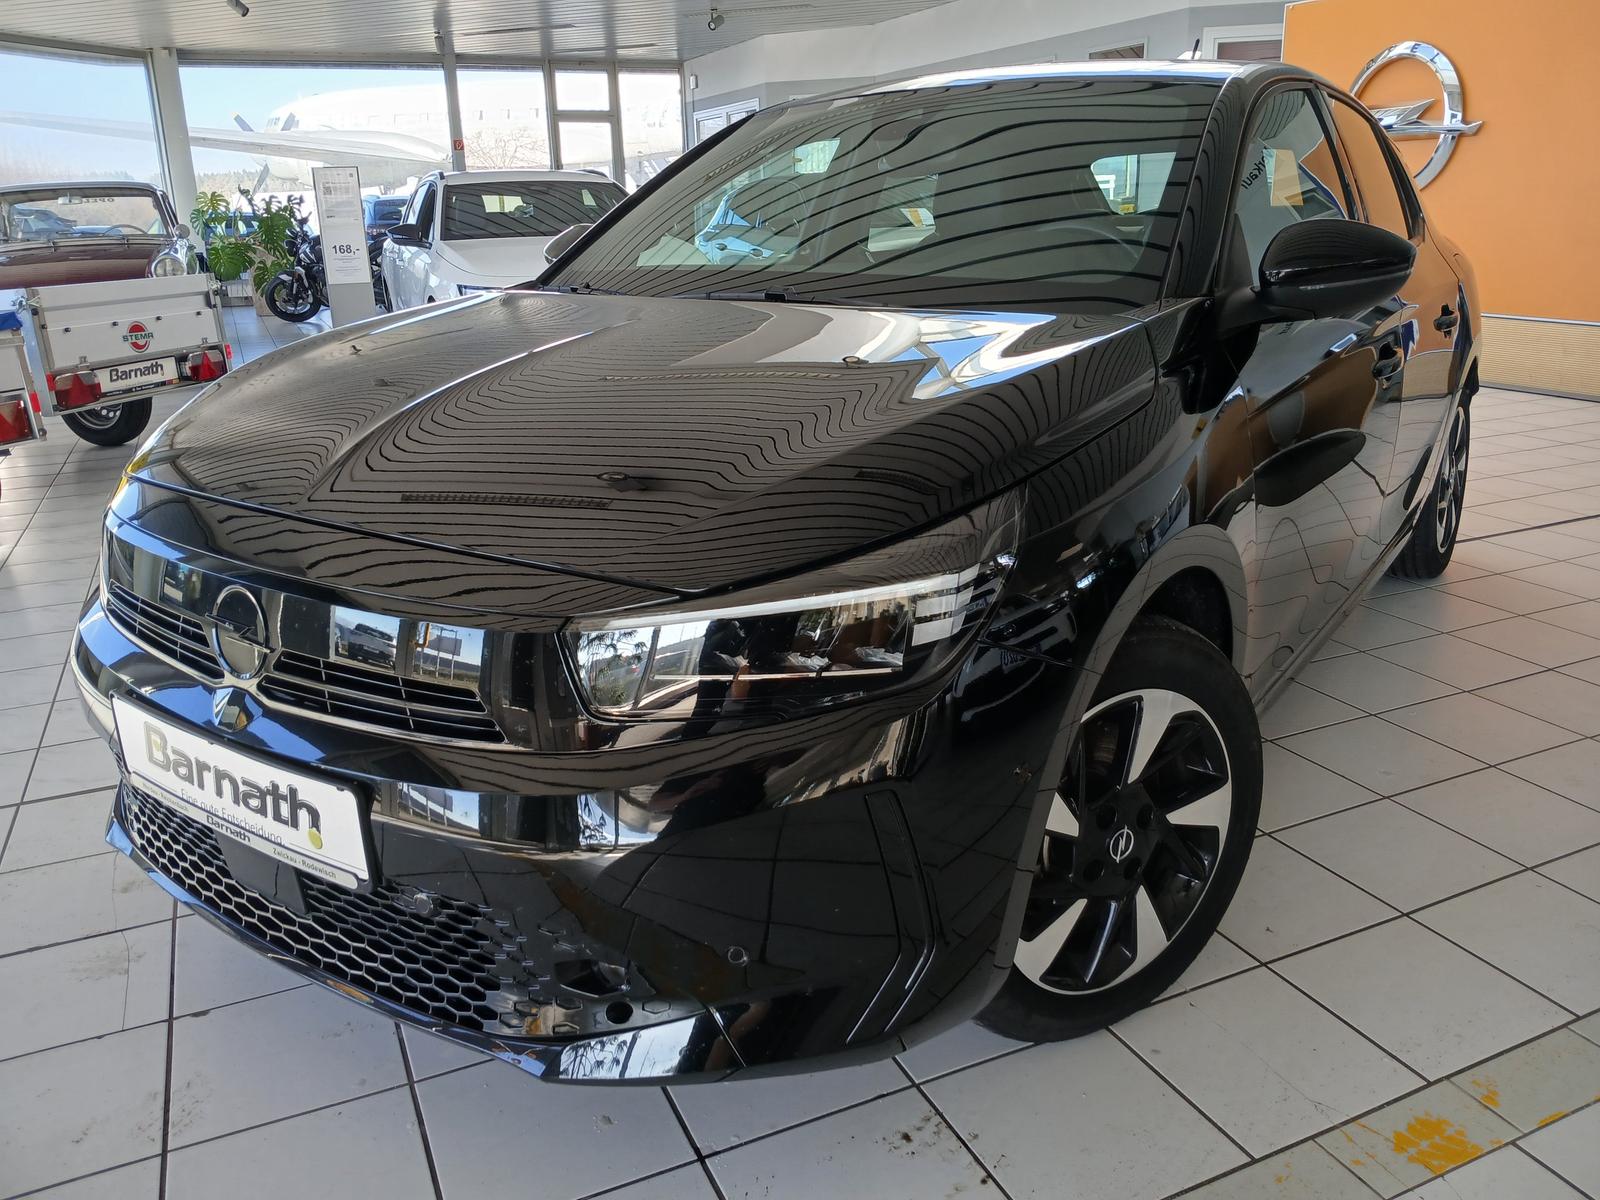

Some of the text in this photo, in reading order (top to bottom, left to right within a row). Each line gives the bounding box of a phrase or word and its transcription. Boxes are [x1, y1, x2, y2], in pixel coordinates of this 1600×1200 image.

[332, 244, 360, 255] 168,-
[122, 331, 154, 343] STEMA
[109, 361, 164, 383] Barnath
[143, 720, 322, 835] Barnath
[206, 813, 252, 844] Barnath
